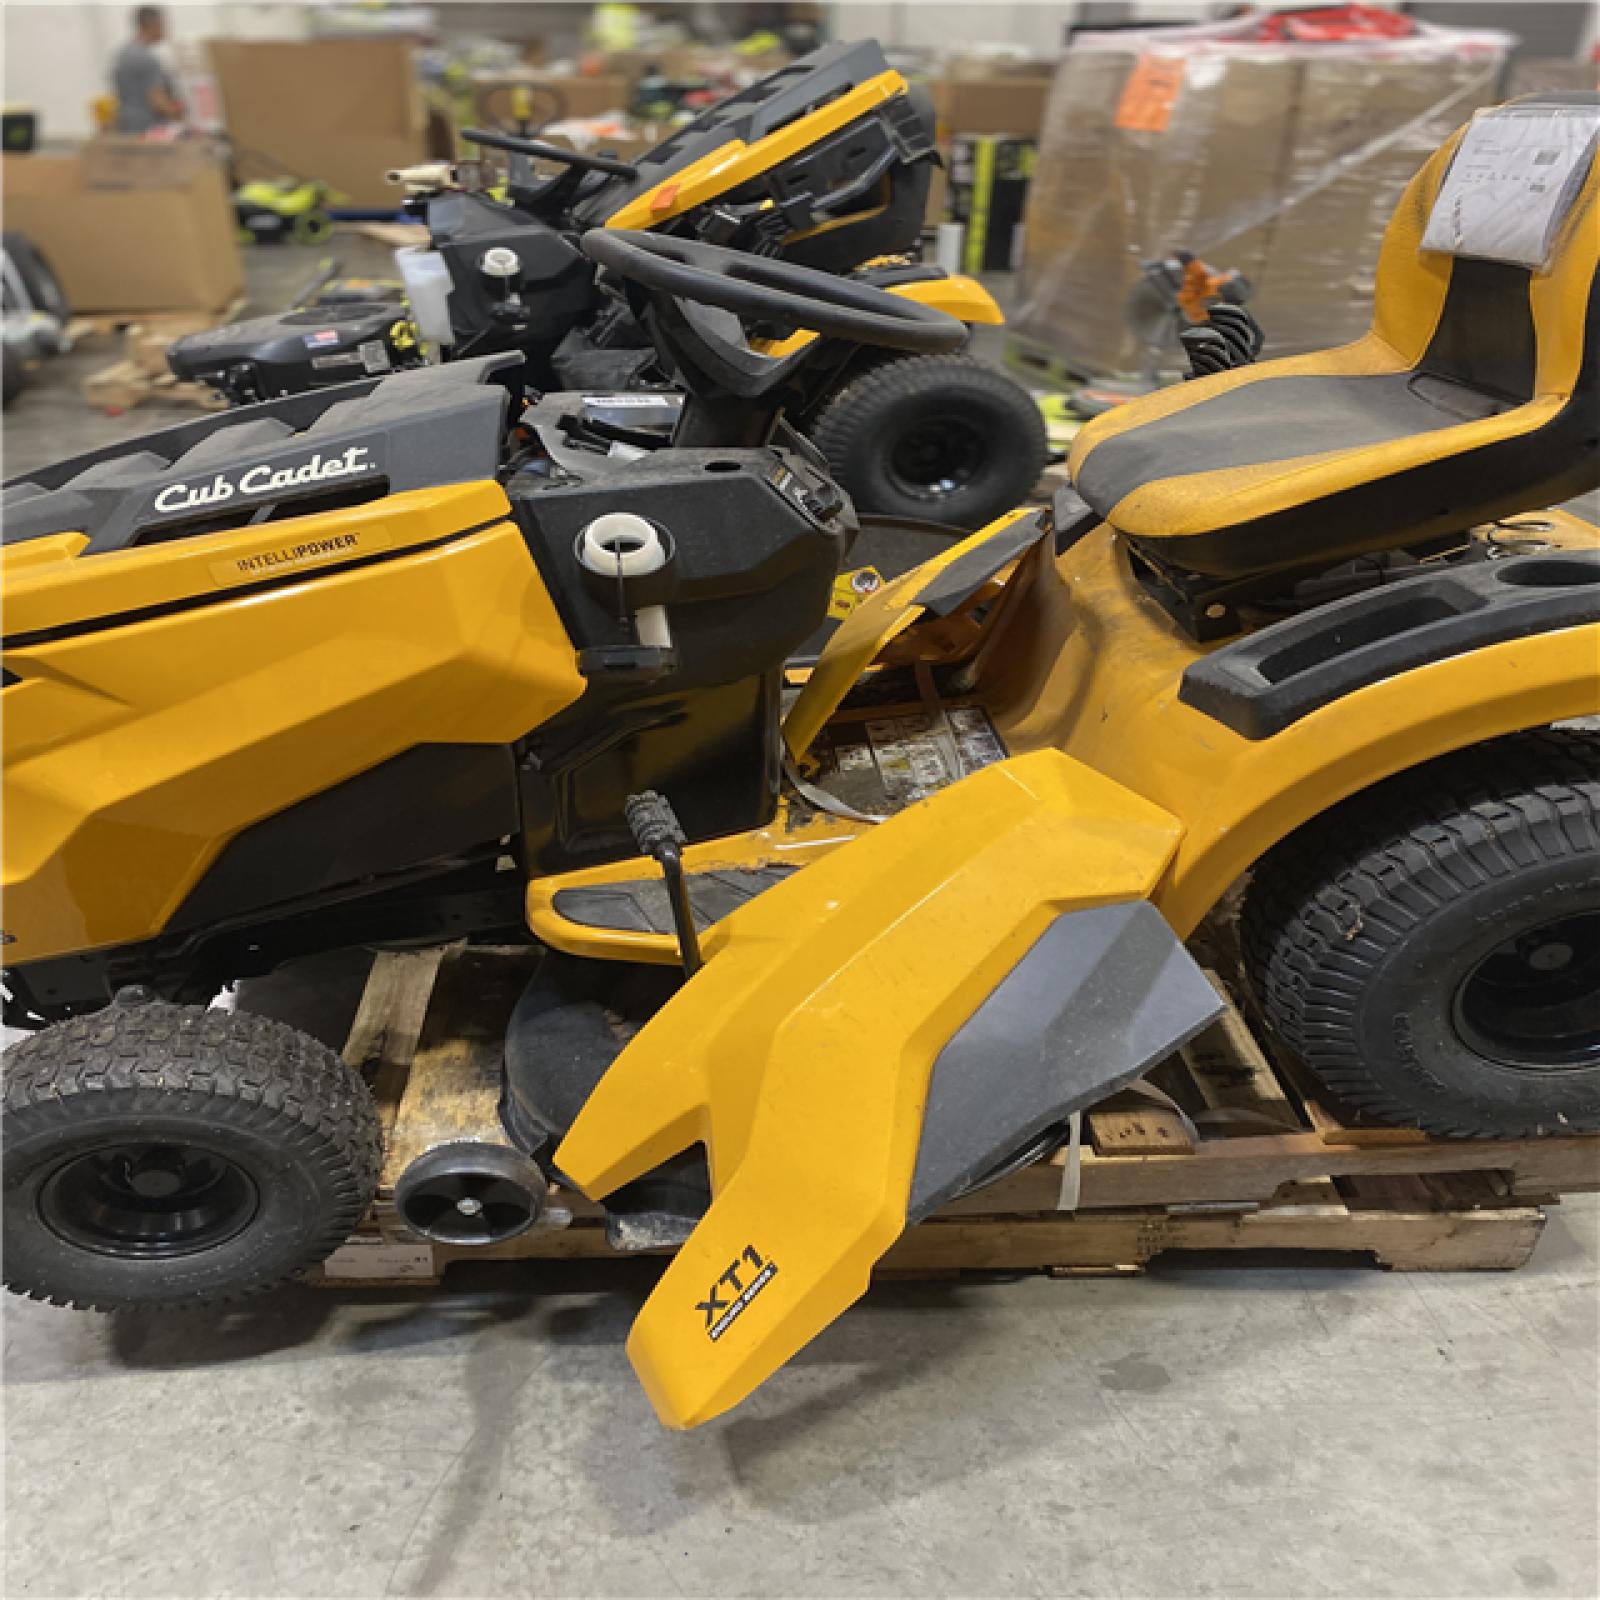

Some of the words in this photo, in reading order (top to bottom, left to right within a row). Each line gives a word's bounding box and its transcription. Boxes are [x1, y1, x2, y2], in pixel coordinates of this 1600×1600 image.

[154, 475, 235, 512] Cub
[239, 447, 369, 494] Cadet
[695, 1244, 763, 1329] XT1
